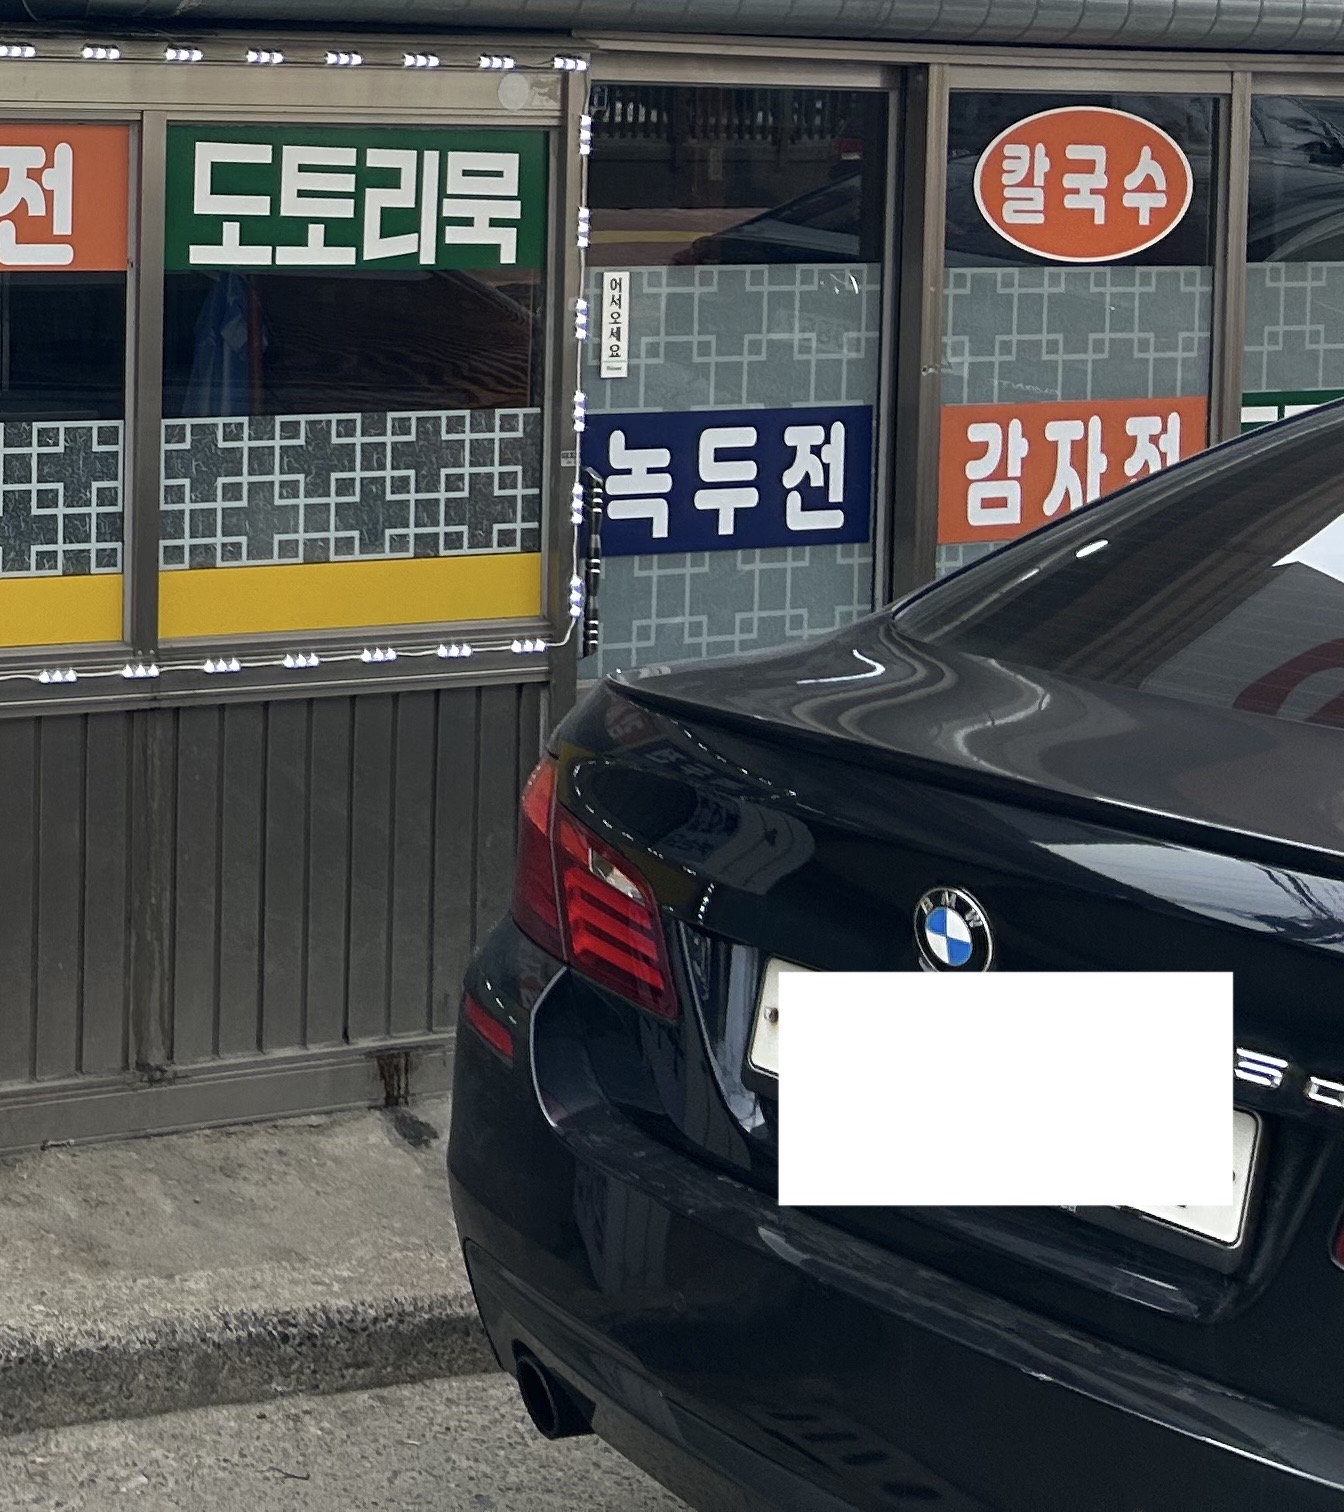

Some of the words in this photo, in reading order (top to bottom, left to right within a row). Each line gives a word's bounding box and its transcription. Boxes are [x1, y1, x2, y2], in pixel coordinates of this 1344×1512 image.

[188, 140, 522, 266] 도토리묵
[1001, 143, 1168, 226] 칼국수
[608, 276, 623, 358] 어서오세요
[604, 420, 846, 539] 녹두전
[920, 890, 984, 928] BMW
